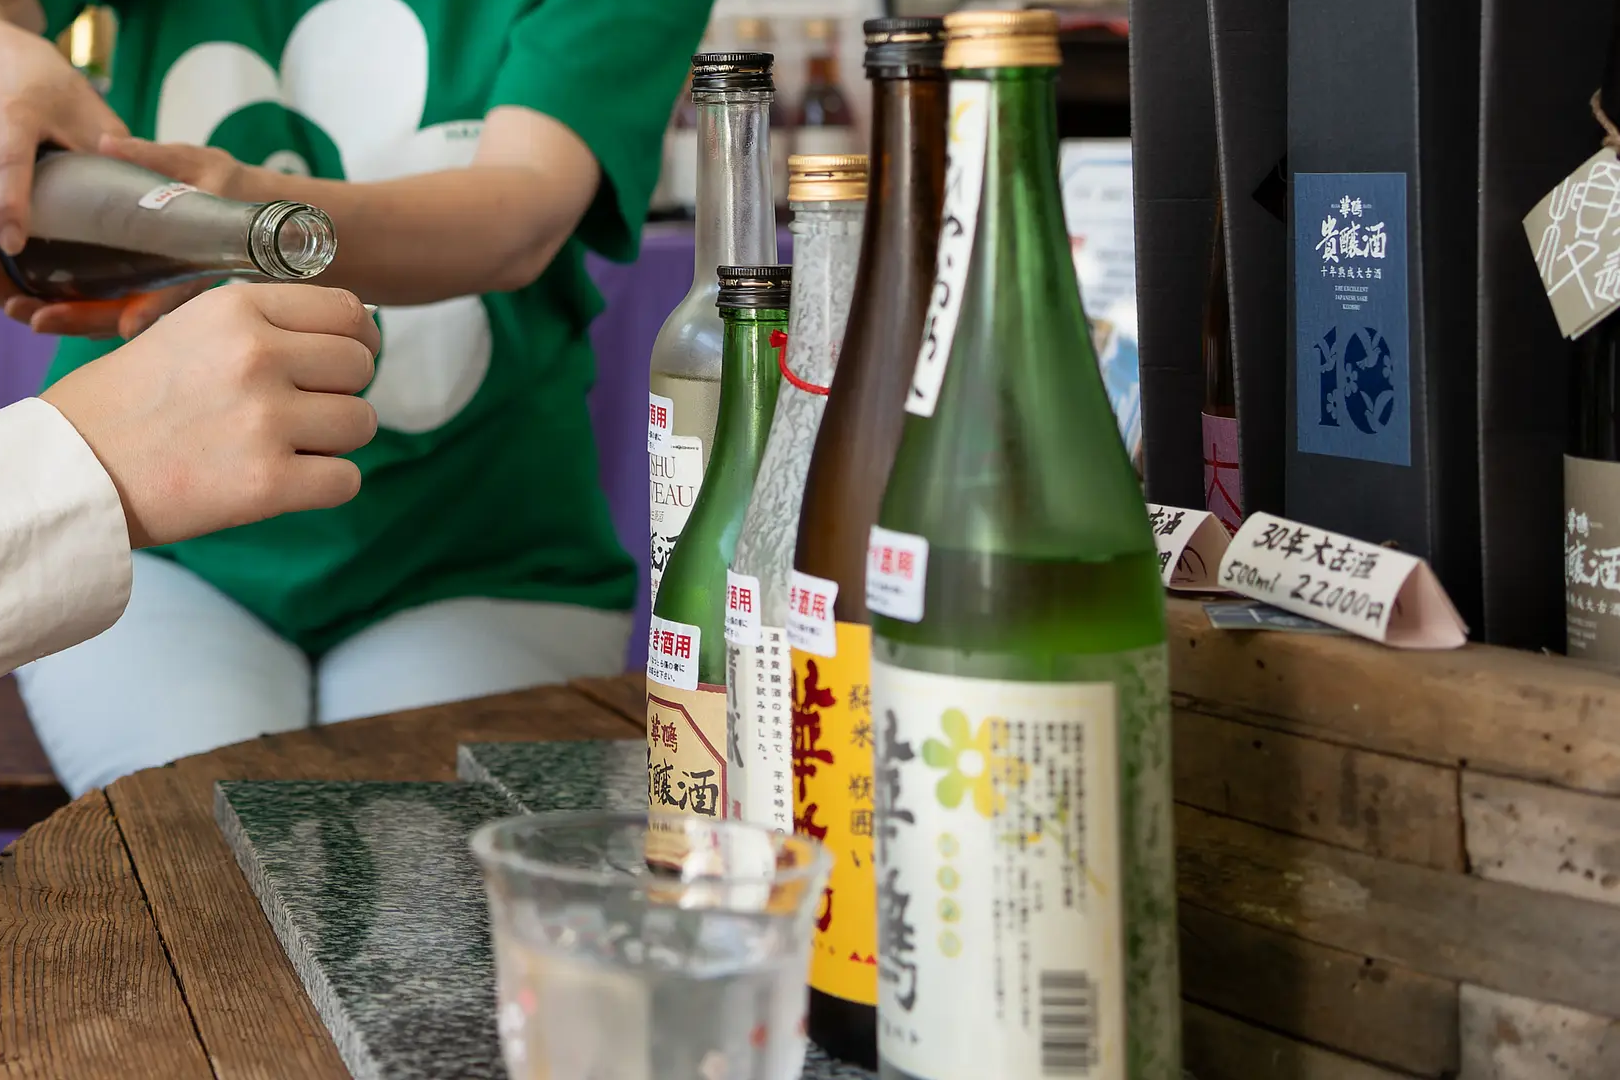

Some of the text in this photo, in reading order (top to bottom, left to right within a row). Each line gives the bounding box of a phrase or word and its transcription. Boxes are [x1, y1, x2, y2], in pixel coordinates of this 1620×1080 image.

[1315, 215, 1386, 263] 貴醸酒
[1320, 265, 1382, 279] 十年熟成大古酒
[1253, 523, 1380, 580] 30年大古酒
[1565, 540, 1620, 591] 醸酒
[1223, 560, 1384, 628] 500ml 22000円
[651, 627, 691, 659] き酒用
